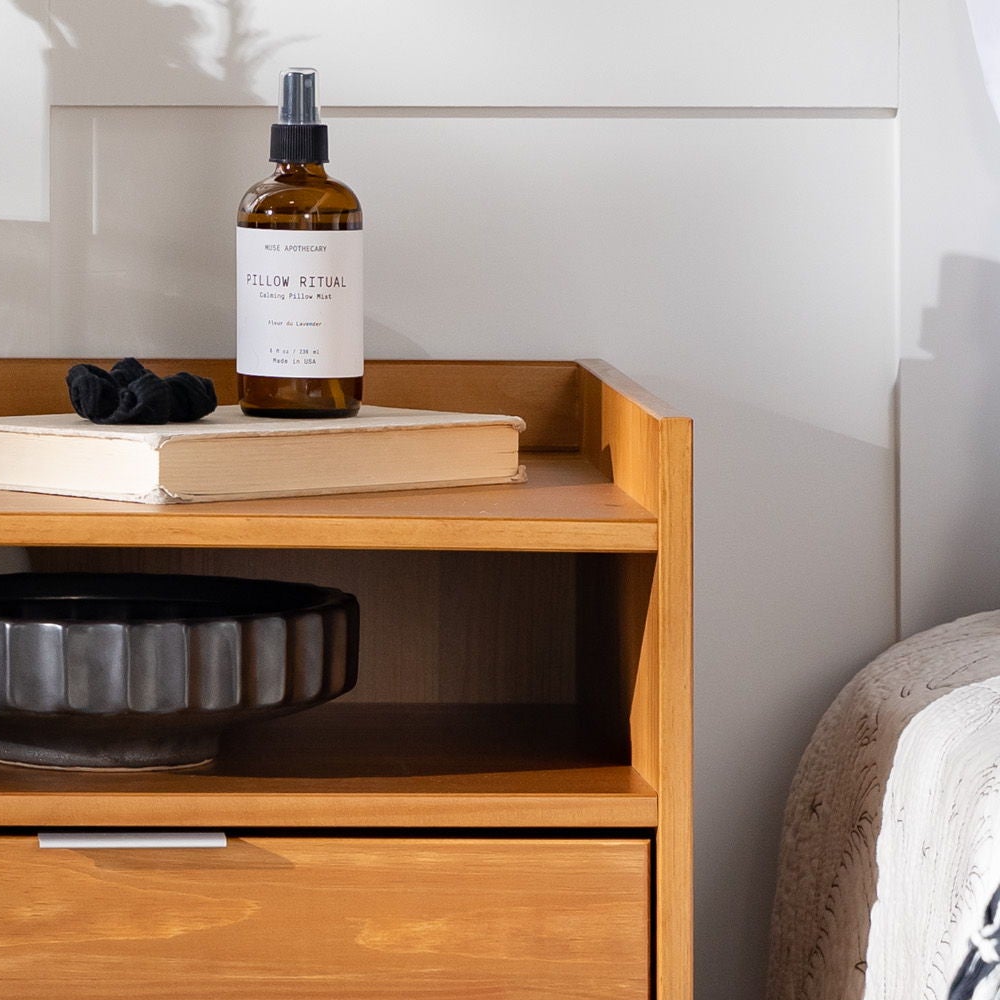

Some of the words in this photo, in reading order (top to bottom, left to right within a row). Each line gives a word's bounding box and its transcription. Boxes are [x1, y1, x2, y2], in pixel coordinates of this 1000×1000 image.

[247, 273, 290, 287] PILLOW
[300, 276, 347, 288] RITUAL
[259, 291, 285, 300] Calming
[289, 292, 313, 300] Pillow
